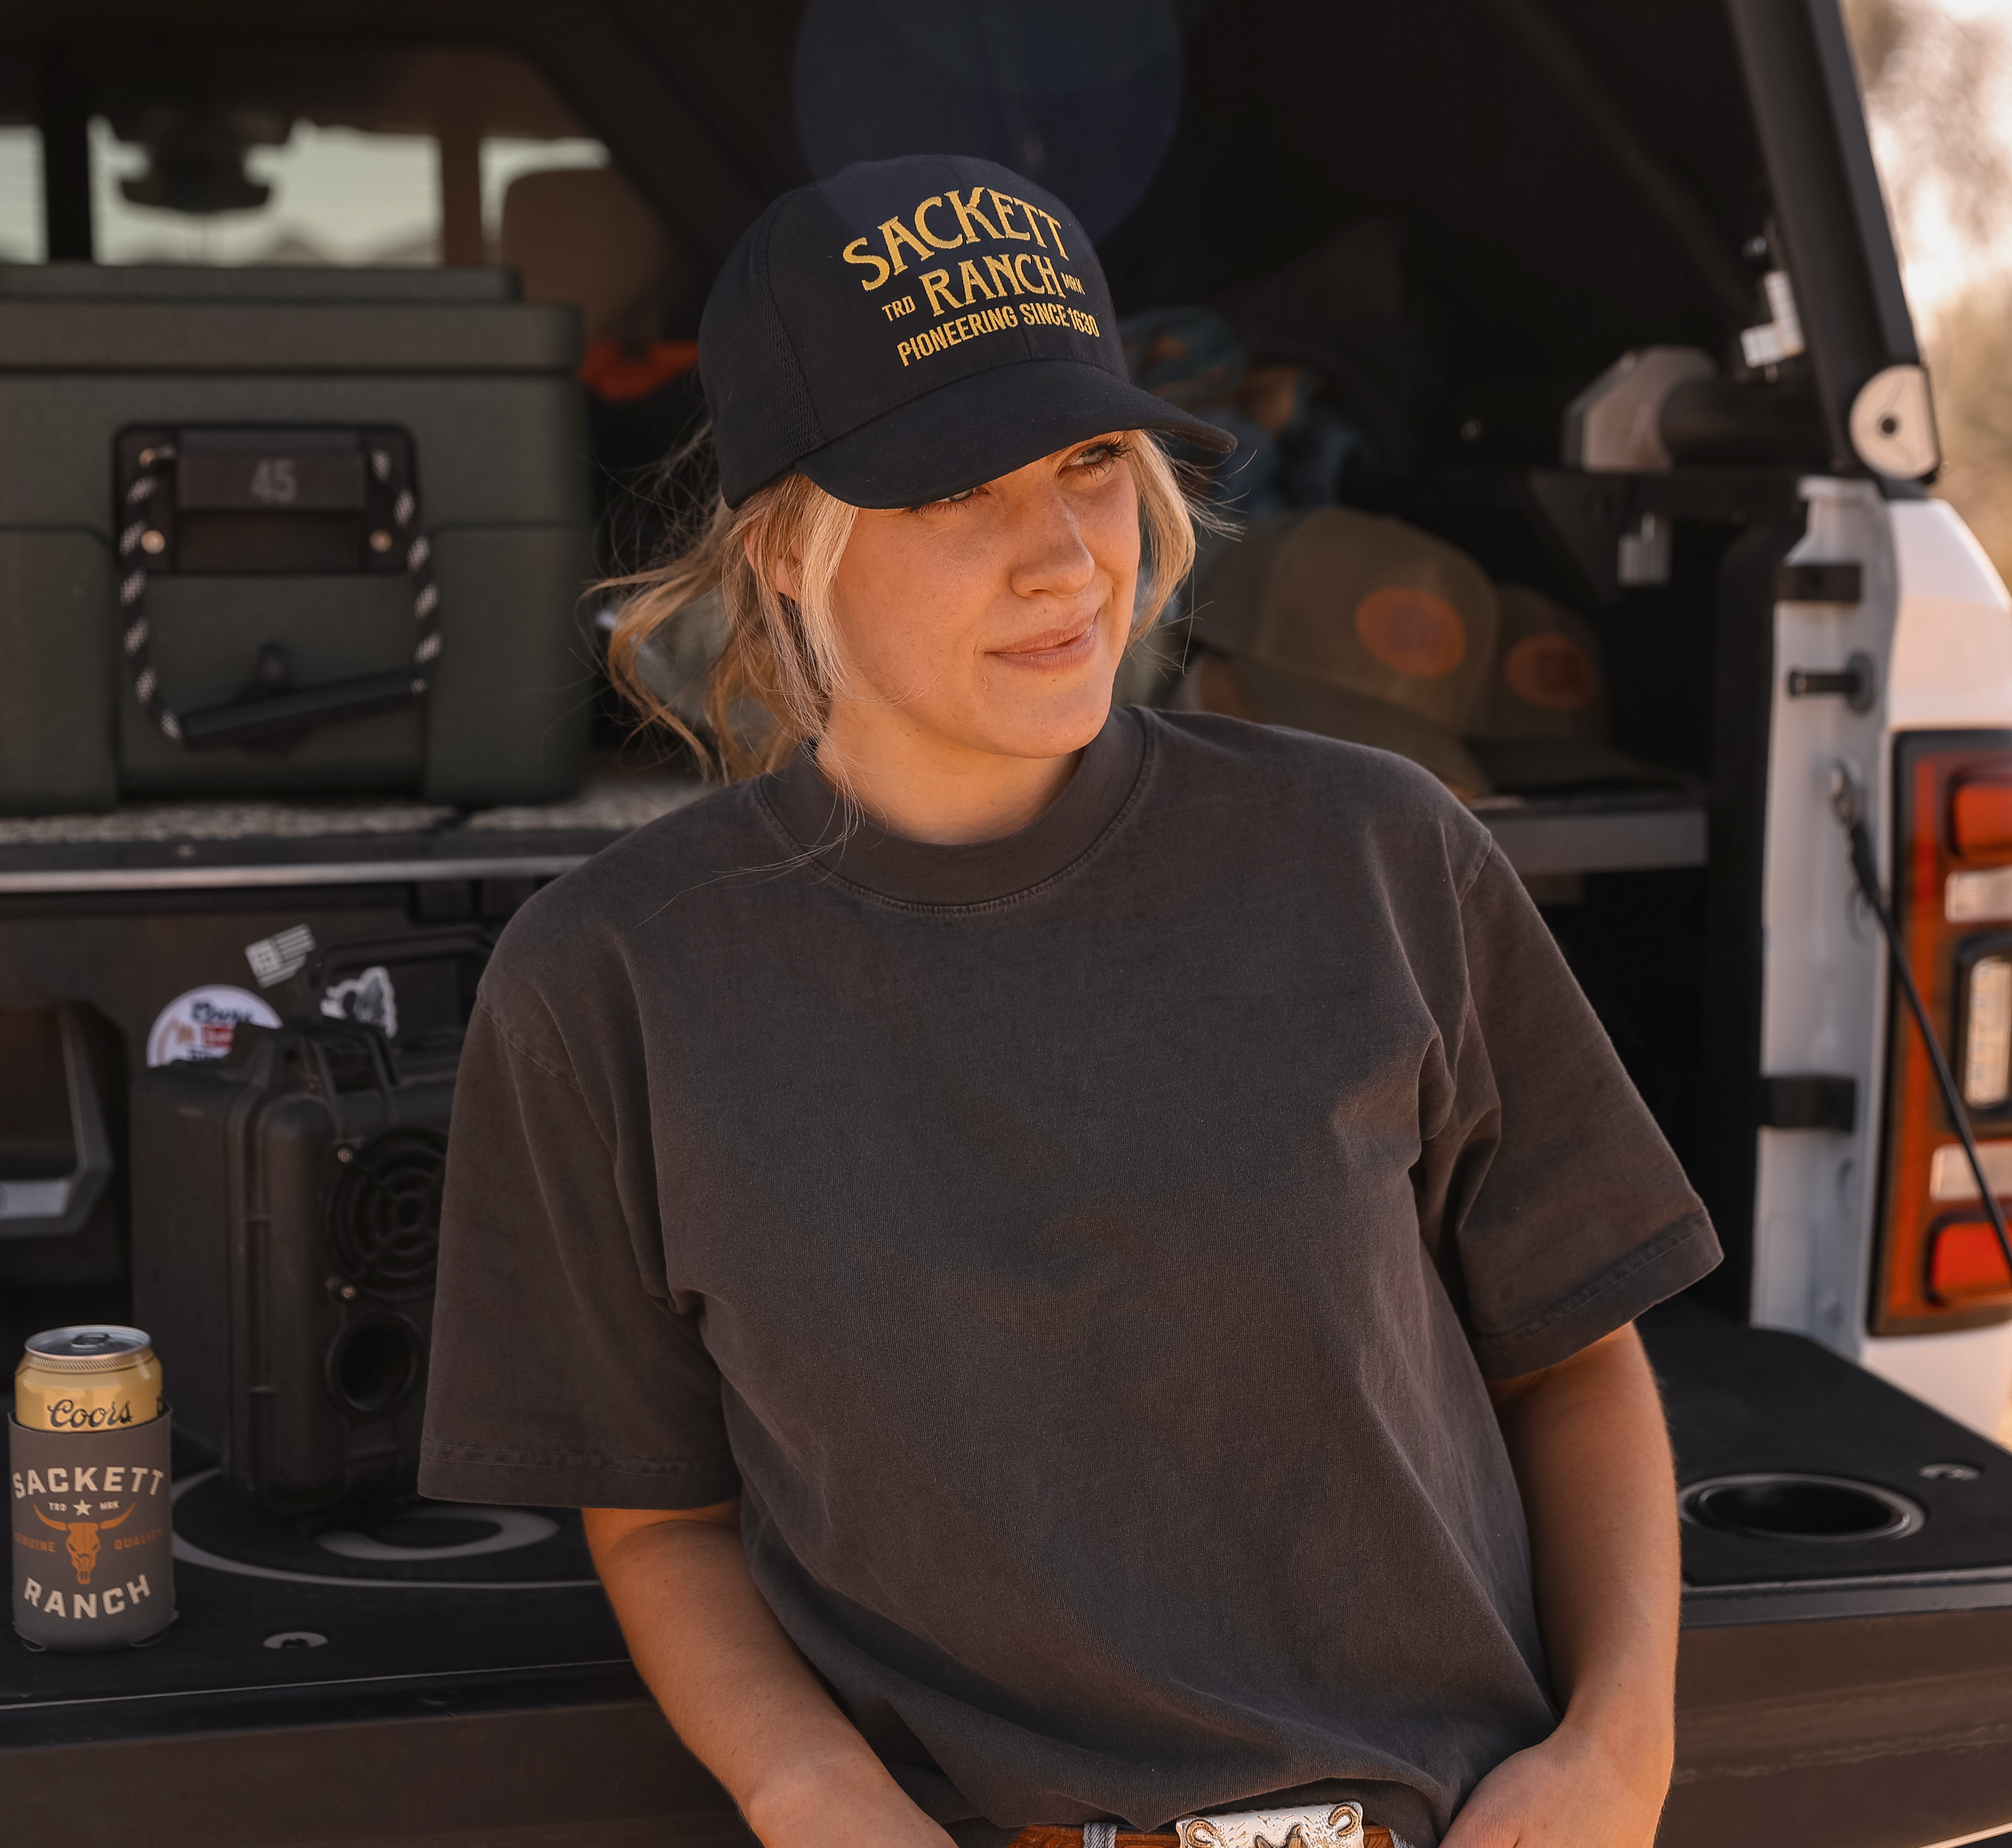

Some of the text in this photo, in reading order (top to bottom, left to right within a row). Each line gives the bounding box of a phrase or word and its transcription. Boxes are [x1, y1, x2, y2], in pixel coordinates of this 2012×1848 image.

[842, 186, 1070, 291] SACKETT
[882, 295, 916, 322] TRD
[918, 253, 1067, 317] RANCH
[897, 303, 1100, 367] PIONEERING SINCE 1630
[249, 457, 299, 504] 45
[47, 1398, 133, 1429] Coors
[12, 1466, 165, 1500] SACKETT
[48, 1501, 67, 1512] TRD
[23, 1573, 151, 1619] RANCH
